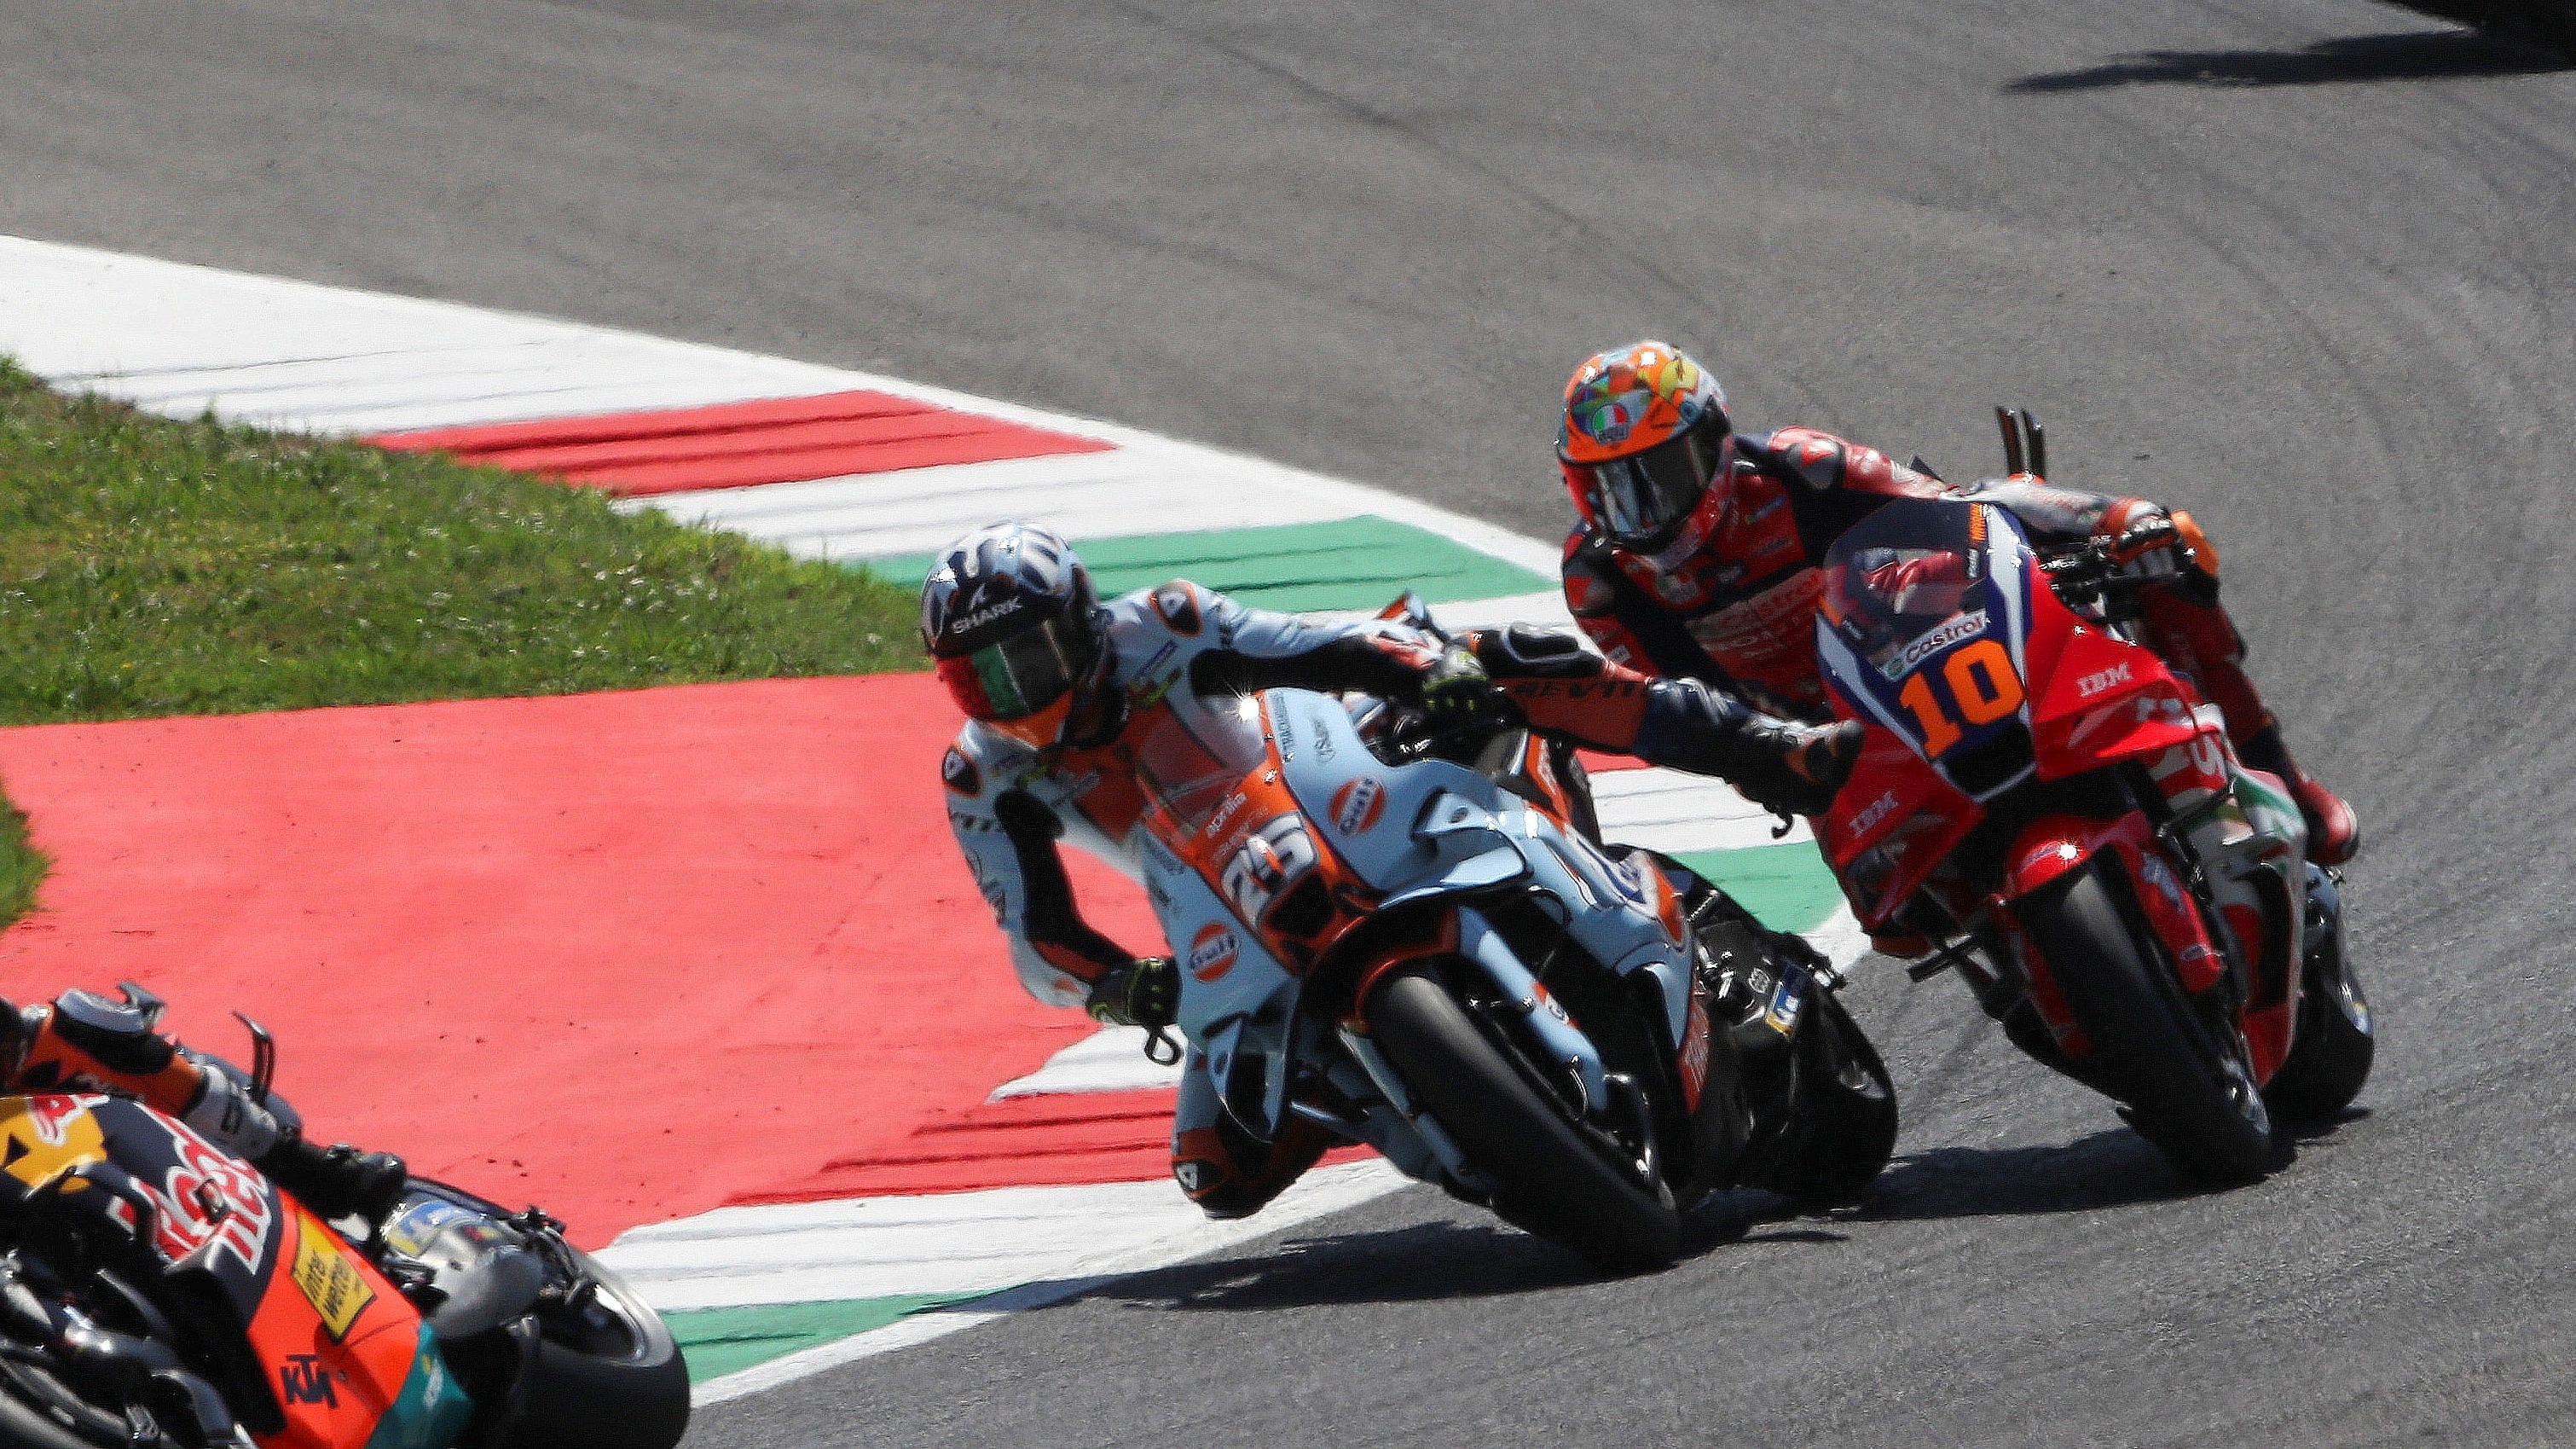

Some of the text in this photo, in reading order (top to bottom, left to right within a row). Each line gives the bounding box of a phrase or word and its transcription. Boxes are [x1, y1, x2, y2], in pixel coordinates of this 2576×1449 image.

[952, 596, 1022, 634] SHARK
[1905, 615, 1985, 664] Castrol
[1900, 639, 2024, 758] 10
[2076, 661, 2133, 698] IBM
[1848, 791, 1899, 838] IBM
[1221, 810, 1319, 930] 25
[281, 1353, 338, 1409] KTM
